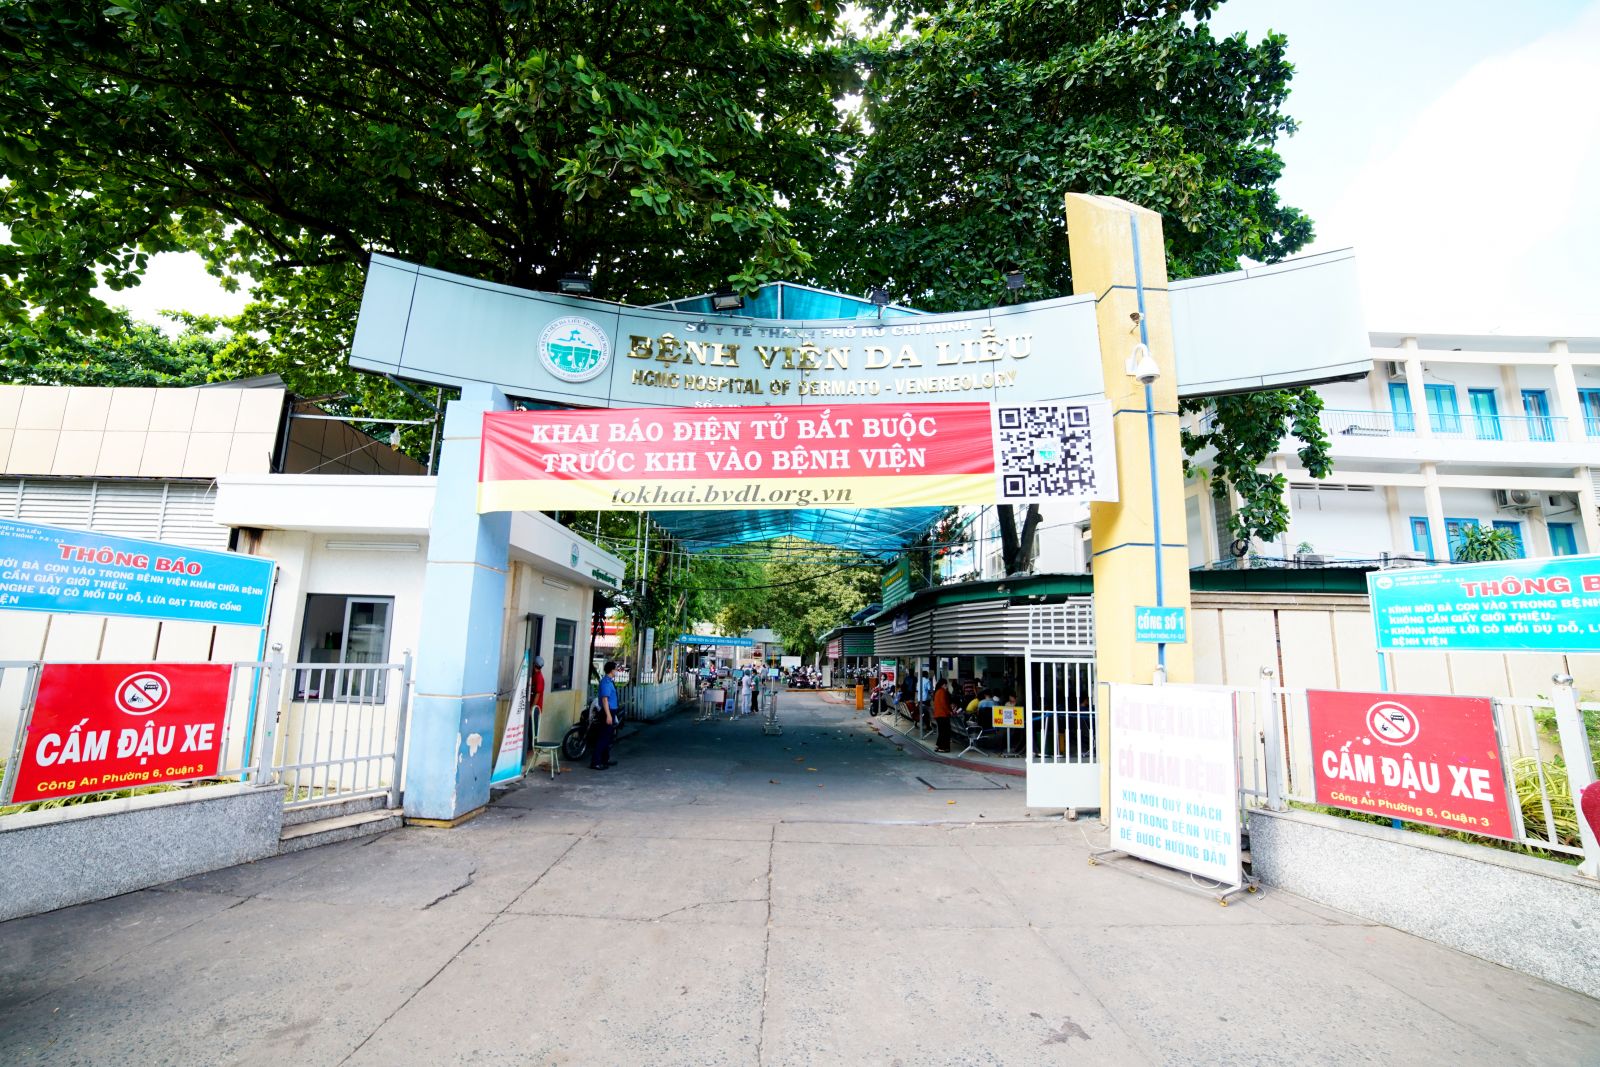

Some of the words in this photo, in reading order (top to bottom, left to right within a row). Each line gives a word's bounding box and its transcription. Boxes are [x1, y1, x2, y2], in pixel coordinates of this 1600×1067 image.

[926, 322, 972, 334] MINH
[626, 332, 740, 368] BỆNH
[754, 340, 850, 376] VIỆN
[864, 344, 922, 370] DA
[936, 326, 1032, 366] LIỄU
[631, 368, 680, 388] HCMC
[684, 374, 764, 395] HOSPITAL
[770, 378, 790, 396] OF
[798, 378, 880, 396] DERMATO
[530, 424, 600, 444] KHAI
[608, 418, 664, 442] BÁO
[673, 416, 741, 446] ĐIỆN
[751, 412, 788, 440] TỬ
[798, 408, 854, 439] BẮT
[862, 412, 938, 442] BUỘC
[542, 448, 636, 472] TRƯỚC
[644, 452, 696, 472] KHI
[706, 446, 762, 470] VÀO
[772, 444, 850, 474] BỆNH
[858, 442, 926, 472] VIỆN
[611, 484, 852, 506] tokhai.bvdl.org.vn
[58, 543, 149, 570] THÔNG
[155, 556, 202, 576] BÁO
[22, 560, 40, 570] BÀ
[44, 563, 69, 574] CON
[73, 566, 96, 576] VÀO
[99, 569, 134, 580] TRONG
[136, 573, 164, 584] BỆNH
[166, 576, 188, 588] VIỆN
[190, 579, 216, 590] KHÁM
[218, 582, 240, 592] CHỮA
[242, 586, 263, 596] BỆNH
[34, 572, 62, 584] GIẤY
[94, 579, 128, 590] THIỆU.
[1461, 576, 1572, 598] THÔNG
[0, 582, 36, 594] NGHE
[39, 585, 60, 596] LỜI
[64, 588, 80, 597] CÒ
[108, 592, 123, 602] DỤ
[168, 598, 186, 608] GẠT
[189, 600, 218, 610] TRƯỚC
[1438, 601, 1452, 612] BÀ
[1456, 602, 1479, 612] CON
[1482, 600, 1508, 610] VÀO
[1510, 600, 1557, 610] TRONG
[1138, 609, 1162, 630] CỔNG
[1164, 612, 1177, 630] SỐ
[1178, 616, 1184, 630] 1
[1391, 624, 1426, 634] KHÔNG
[1428, 626, 1458, 634] NGHE
[1460, 624, 1480, 634] LỜI
[1482, 622, 1500, 634] CÒ
[1532, 624, 1552, 635] DỤ
[1451, 612, 1477, 622] GIẤY
[1392, 636, 1420, 647] BỆNH
[1422, 636, 1448, 647] VIỆN
[36, 718, 110, 767] CẤM
[117, 720, 176, 766] ĐẬU
[180, 723, 215, 753] XE
[37, 779, 76, 792] Công
[80, 777, 98, 788] An
[102, 768, 150, 784] Phường
[153, 769, 162, 778] 6,
[166, 764, 194, 776] Quận
[197, 764, 204, 772] 3
[1322, 740, 1376, 784] CẤM
[1382, 752, 1440, 800] ĐẬU
[1448, 765, 1494, 802] XE
[1122, 788, 1137, 803] XIN
[1139, 812, 1169, 830] TRONG
[1331, 791, 1358, 804] Công
[1378, 800, 1424, 816] Phường
[1426, 806, 1438, 819] 6,
[1441, 810, 1478, 825] Quận
[1481, 817, 1490, 827] 3
